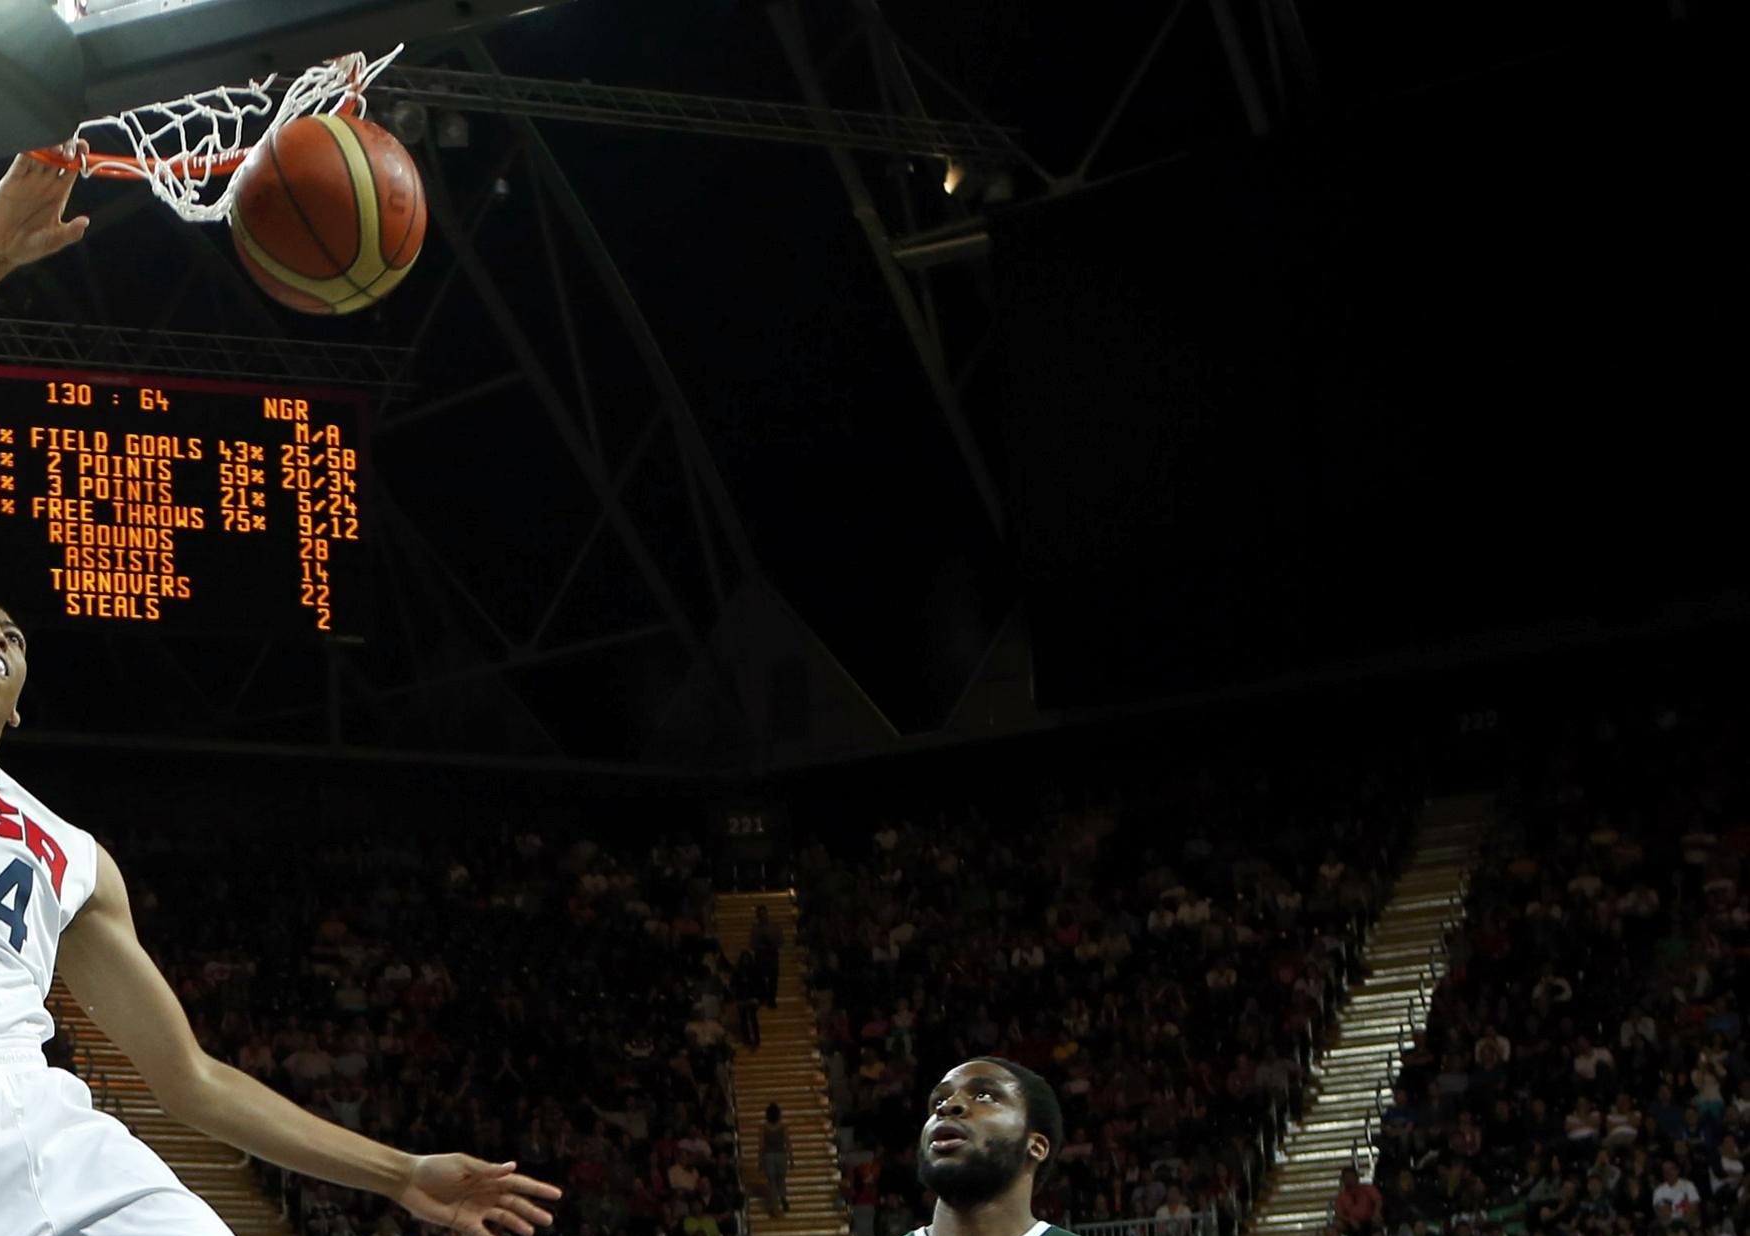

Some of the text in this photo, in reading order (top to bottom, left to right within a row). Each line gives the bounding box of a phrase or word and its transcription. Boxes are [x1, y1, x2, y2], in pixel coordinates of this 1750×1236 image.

[47, 383, 91, 405] 130
[140, 389, 170, 411] 64
[264, 398, 308, 420] NGR
[30, 427, 108, 452] FIELD
[125, 434, 203, 460] GOALS
[219, 440, 264, 462] 43%
[281, 444, 356, 470] 25/58
[297, 423, 340, 446] M/A
[47, 452, 61, 473] 2
[79, 453, 172, 480] POINTS
[220, 463, 265, 486] 59%
[282, 467, 356, 493] 20/34
[48, 475, 61, 496] 3
[79, 477, 172, 503] POINTS
[220, 486, 265, 509] 21%
[297, 491, 357, 516] 5/24
[32, 497, 94, 521] FREE
[112, 502, 204, 529] THROWS
[221, 509, 266, 532] 75%
[299, 514, 358, 540] 9/12
[50, 522, 328, 560] REBOUNDS 28
[66, 546, 174, 574] ASSISTS
[302, 561, 329, 583] 14
[50, 568, 190, 598] TURNOVERS
[301, 584, 330, 606] 22
[67, 593, 160, 620] STEALS
[317, 608, 330, 630] 2
